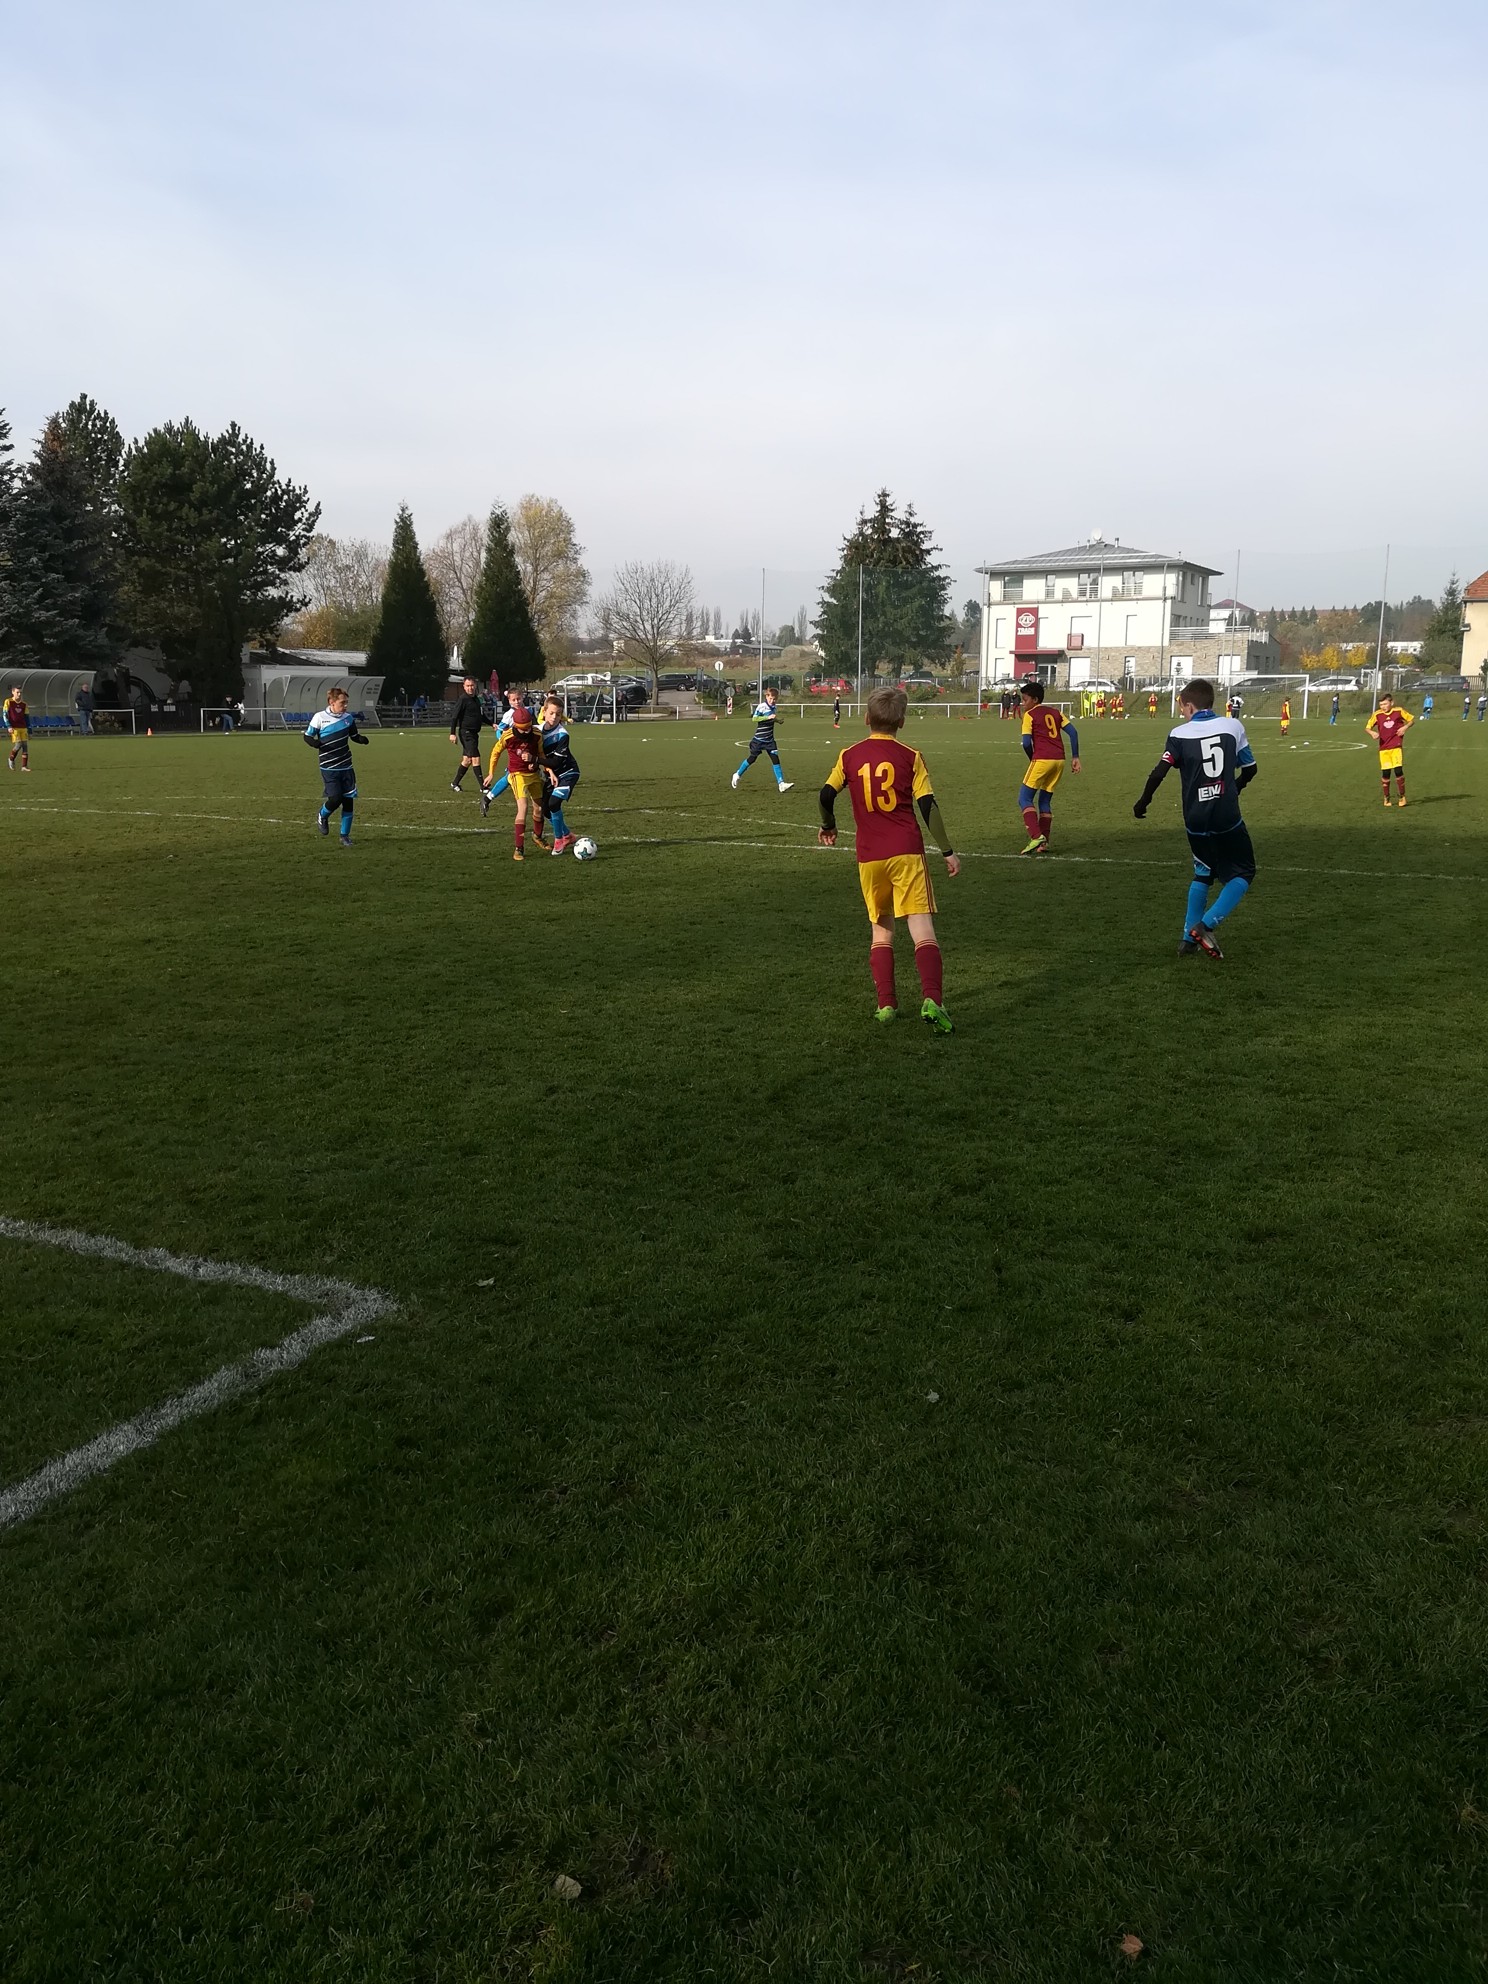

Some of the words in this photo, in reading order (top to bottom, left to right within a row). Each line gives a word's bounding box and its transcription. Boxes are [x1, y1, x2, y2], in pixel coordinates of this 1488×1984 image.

[1044, 713, 1058, 739] 9
[1200, 735, 1225, 778] 5
[857, 761, 897, 813] 13
